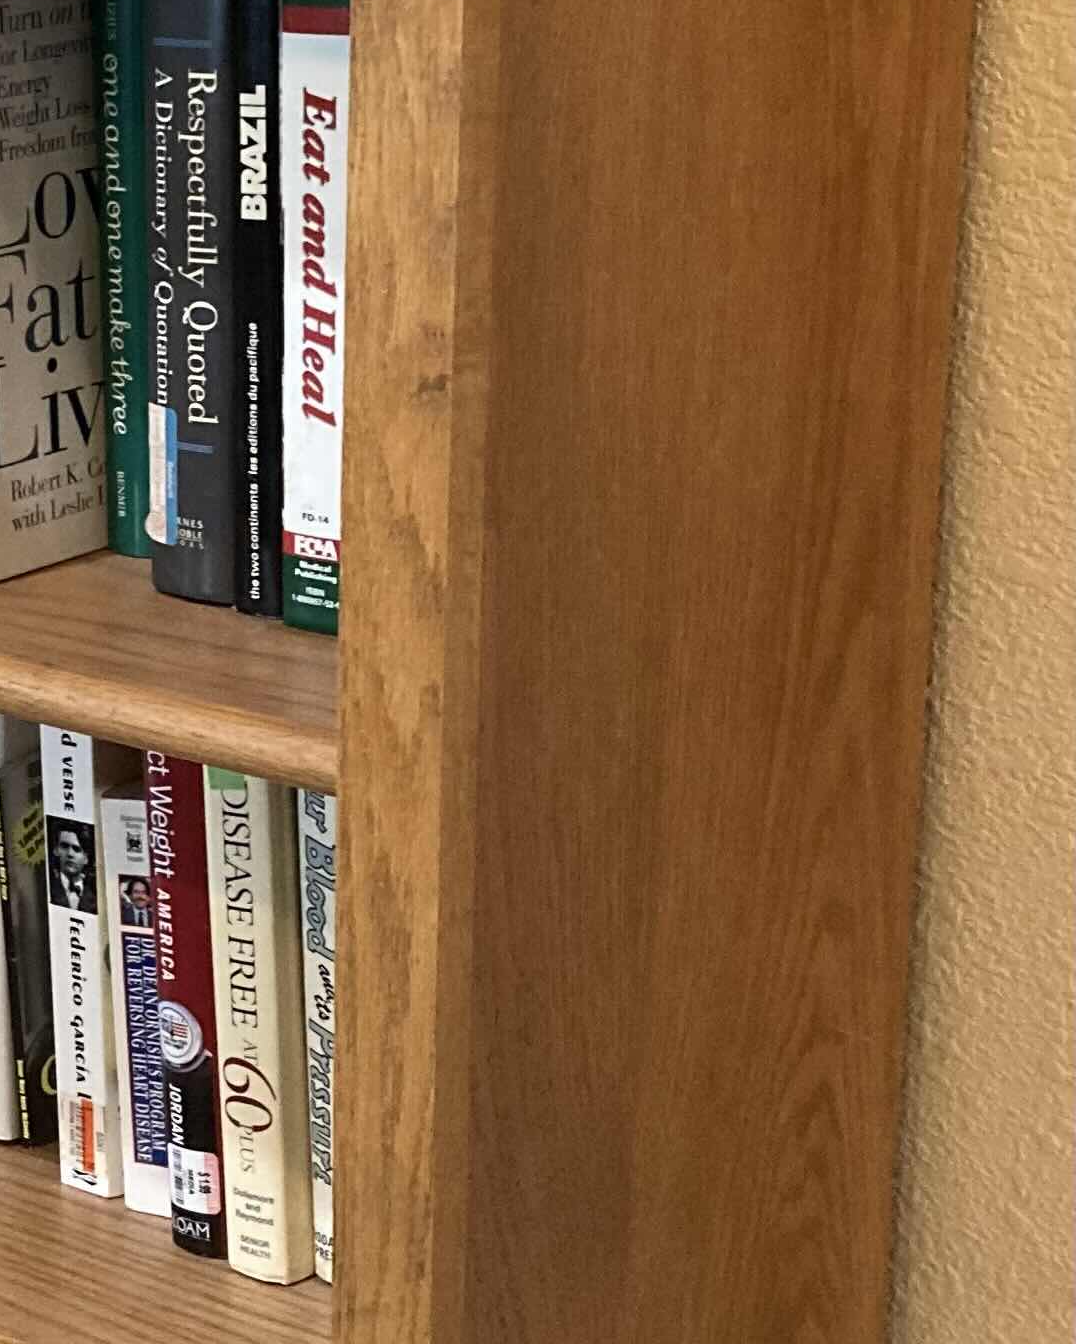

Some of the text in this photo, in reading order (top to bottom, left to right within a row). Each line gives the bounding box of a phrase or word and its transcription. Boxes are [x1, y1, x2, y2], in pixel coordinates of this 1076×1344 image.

[239, 84, 267, 221] BRAZIL
[104, 53, 134, 435] one and one make three
[151, 68, 175, 406] A Dictionary of Quotation
[177, 68, 219, 424] Respectfully Quoted
[301, 86, 338, 427] Eat and Heal
[10, 467, 84, 502] Robert K.
[12, 494, 93, 532] with Leslie
[149, 785, 176, 878] Weight
[156, 888, 176, 981] AMERICA
[221, 787, 259, 1028] DISEASE FREE
[125, 936, 153, 1161] FOR REVERSING HEART DISEASE
[140, 937, 166, 1151] DR. DEAN ORNISH'S PROGRAM
[222, 1056, 278, 1133] 60
[169, 1084, 183, 1144] JORDAN
[233, 1124, 257, 1173] PLUS
